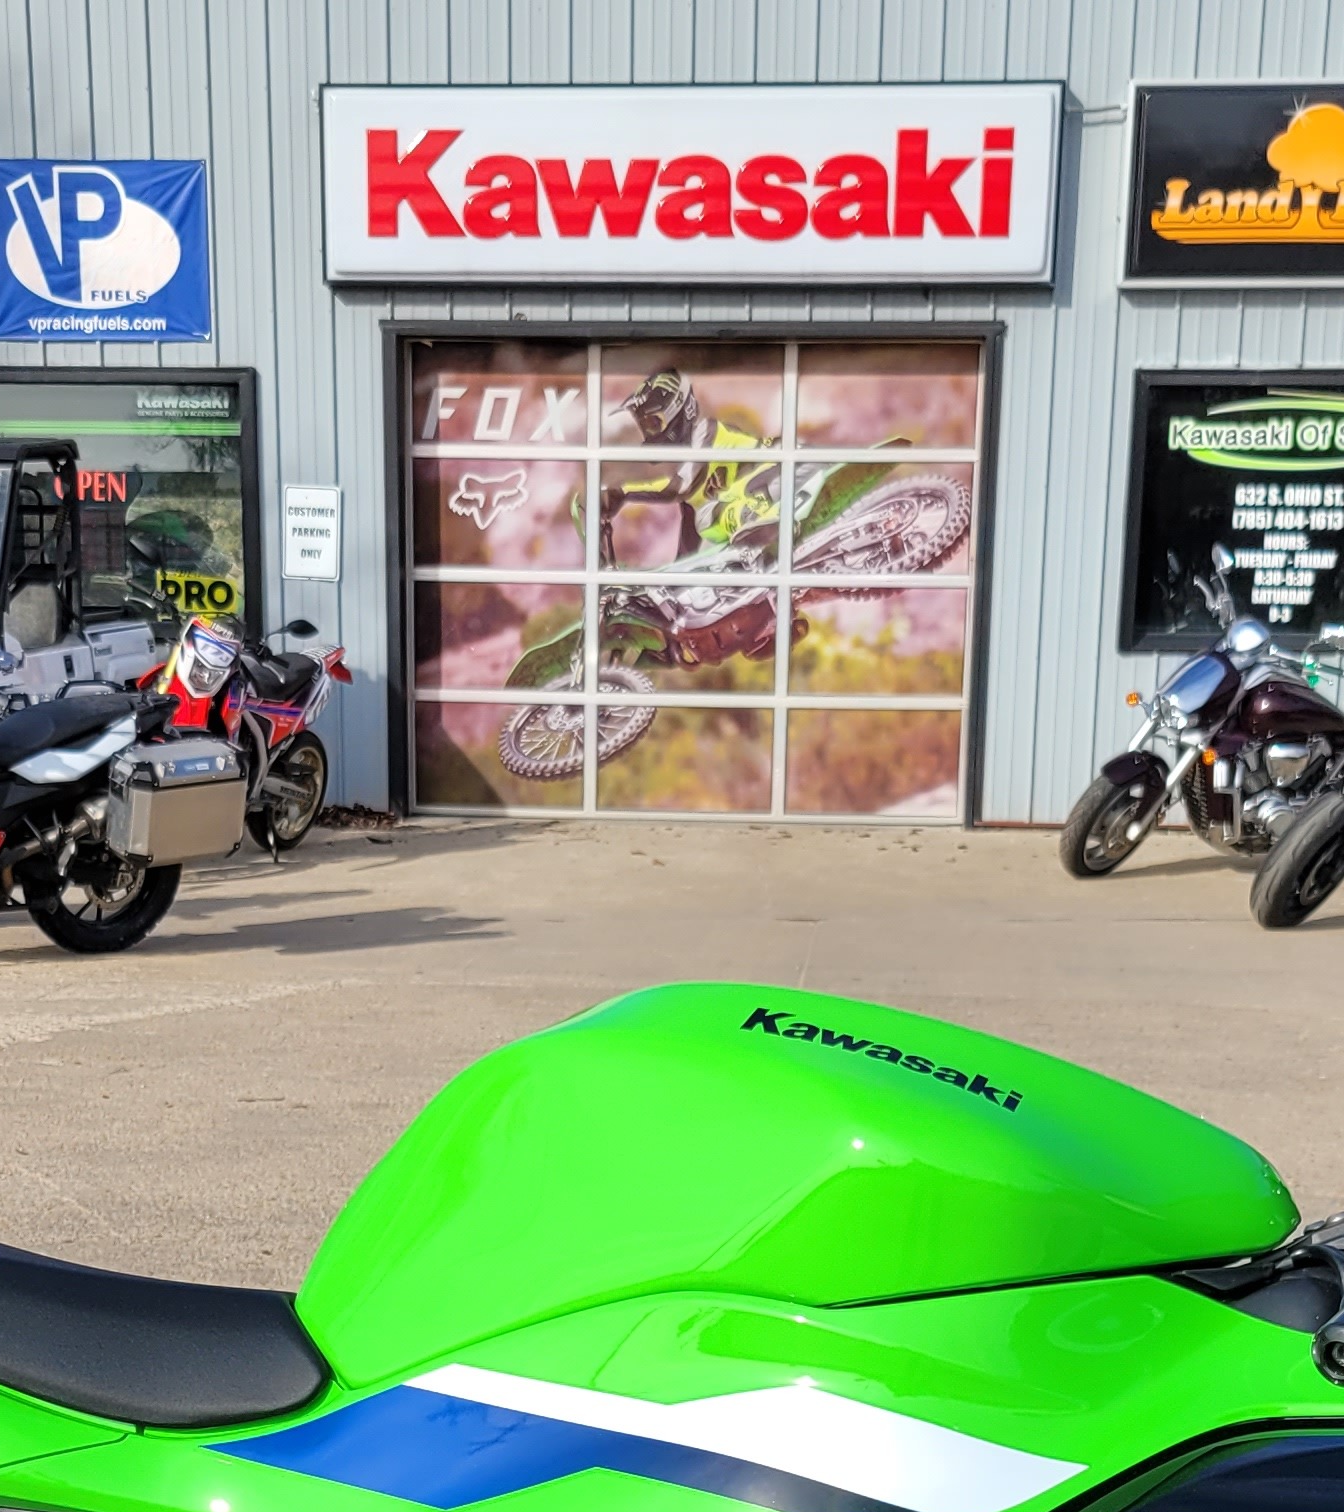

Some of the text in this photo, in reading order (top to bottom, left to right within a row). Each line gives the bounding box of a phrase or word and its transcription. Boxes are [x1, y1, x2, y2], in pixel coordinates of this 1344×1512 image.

[365, 126, 1016, 242] Kawasaki
[1159, 176, 1296, 224] Land
[6, 165, 126, 303] VP
[90, 289, 149, 304] FUELS
[27, 313, 168, 335] vpracingfuels.com
[136, 390, 231, 409] Kawasaki
[422, 386, 581, 442] FOX
[1170, 420, 1291, 449] Kawasaki
[1299, 421, 1331, 449] Of
[1283, 484, 1323, 507] OHIO
[287, 505, 336, 518] CUSTOMER
[292, 527, 331, 539] PARKING
[300, 548, 323, 560] ONLY
[161, 580, 235, 611] PRO
[739, 1007, 1024, 1113] Kawasaki
